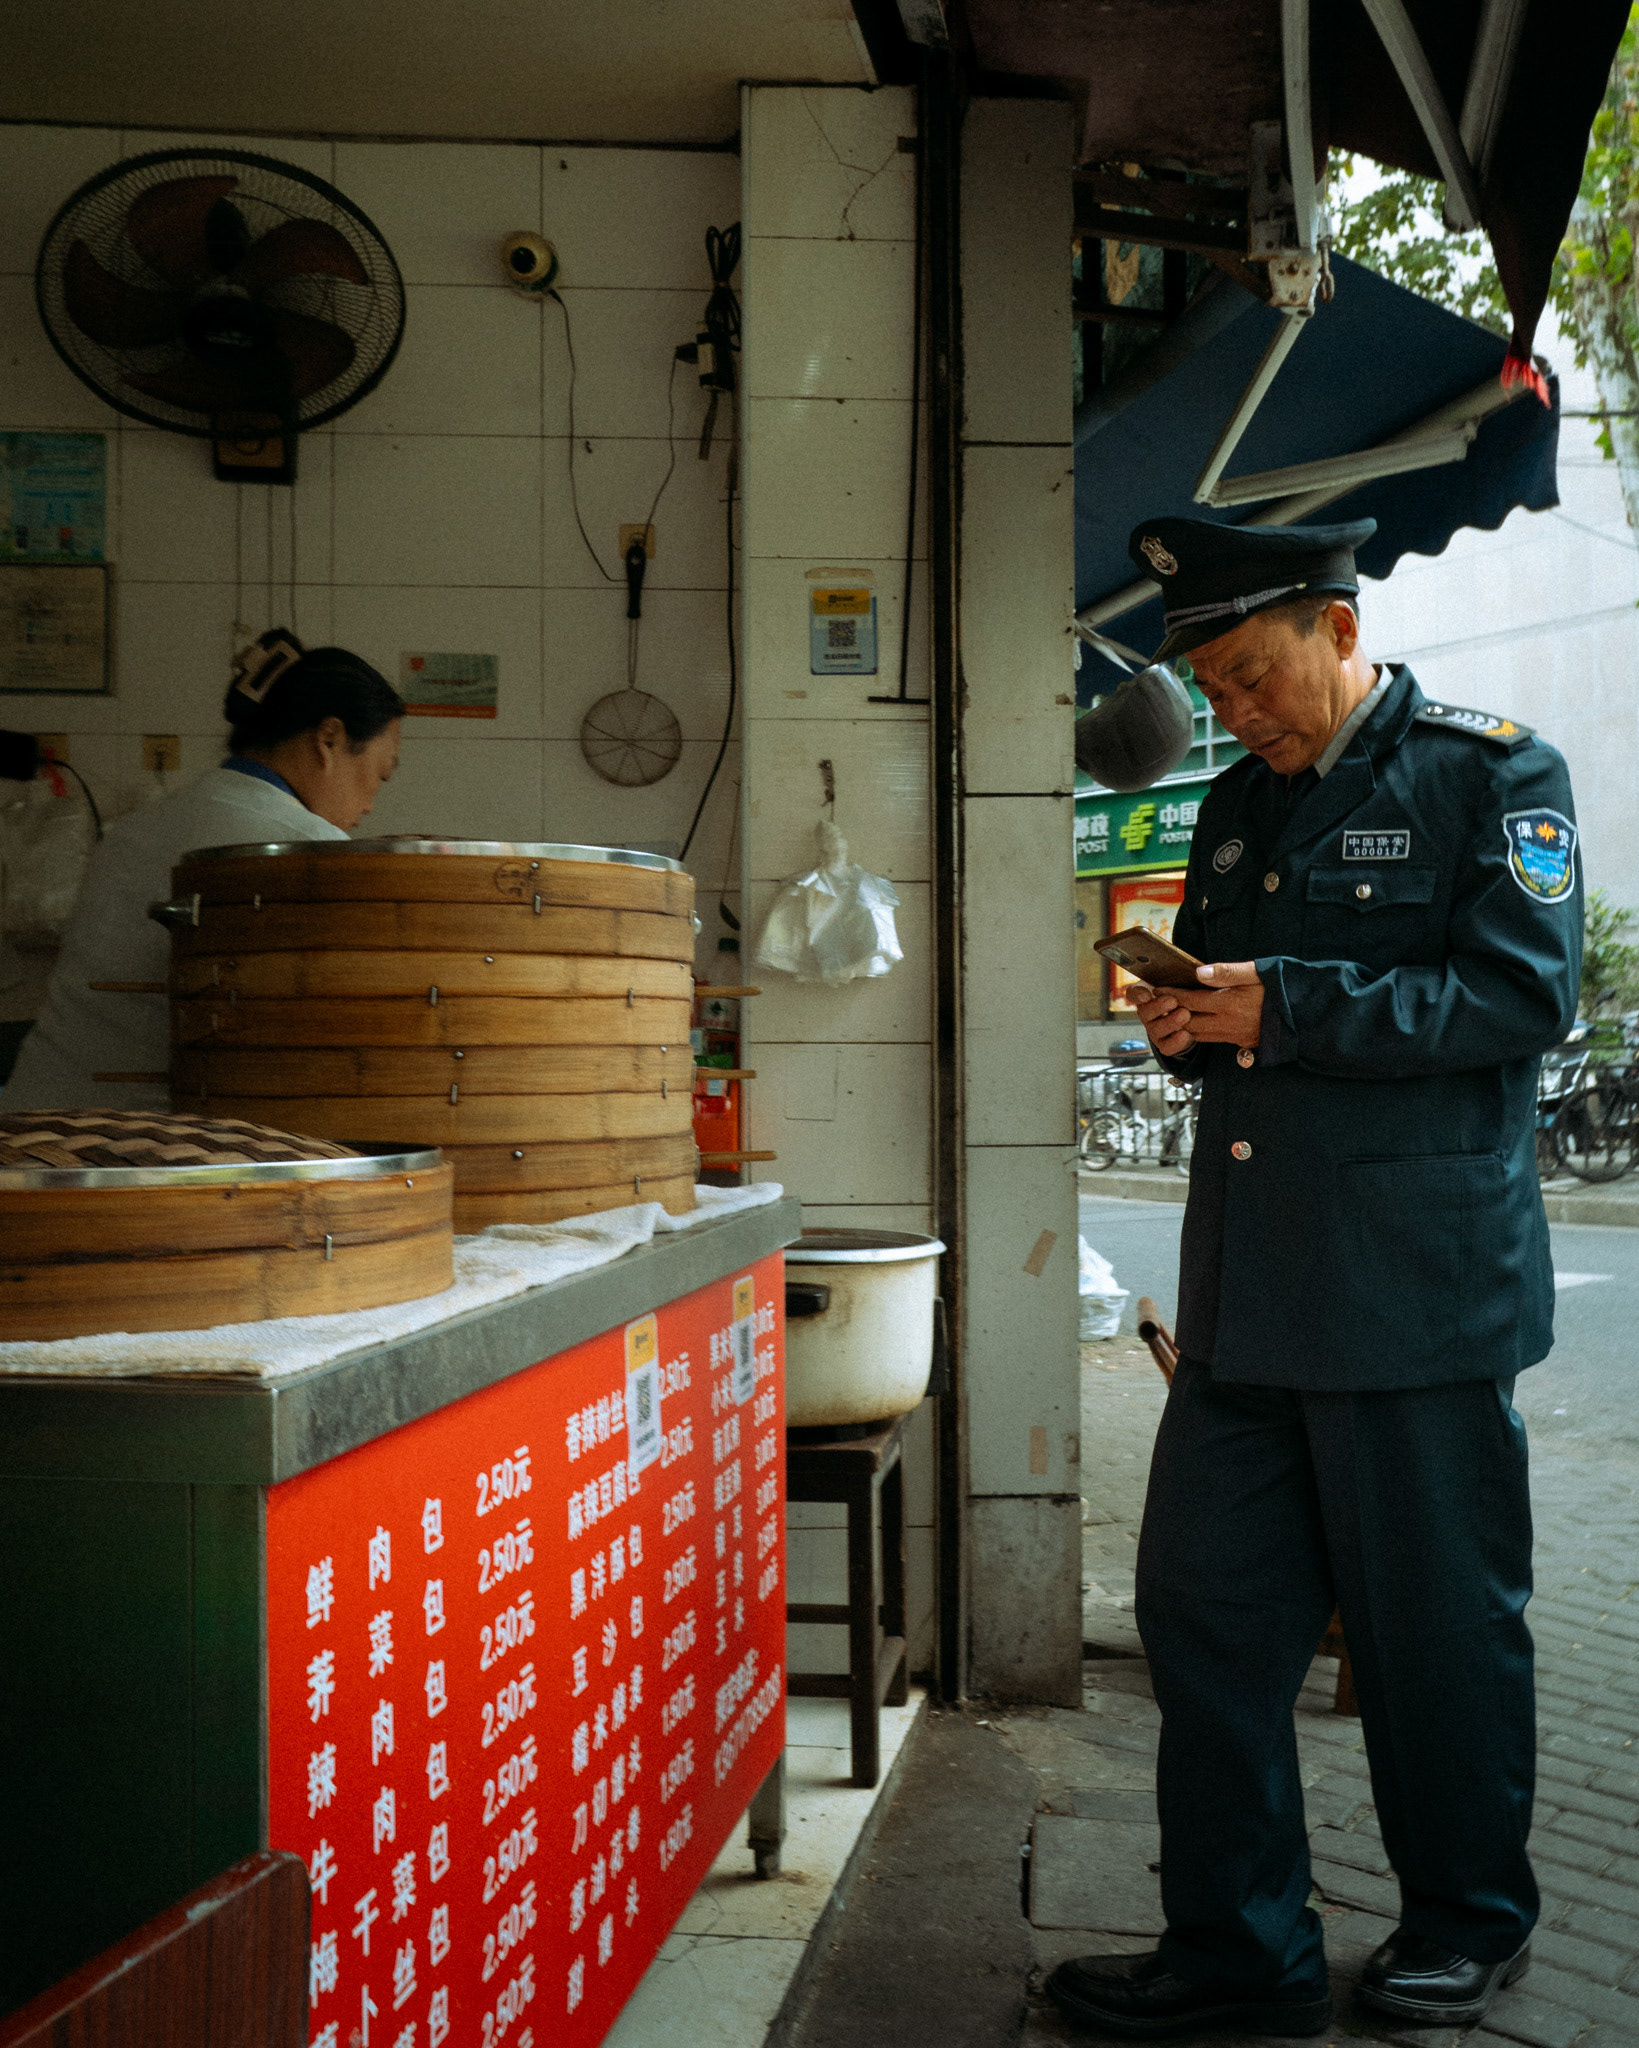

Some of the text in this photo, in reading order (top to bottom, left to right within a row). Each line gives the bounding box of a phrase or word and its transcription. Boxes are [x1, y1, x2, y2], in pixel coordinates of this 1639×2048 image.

[1077, 839, 1110, 855] POST
[1159, 801, 1199, 829] 中国
[1348, 836, 1405, 848] 中国保安
[1516, 821, 1532, 839] 保
[566, 1390, 627, 1464] 香辣粉丝
[660, 1416, 693, 1466] 2.50元
[306, 1446, 532, 1628] 鲜肉包 2.50元
[571, 1481, 695, 1619] 黑洋酥包 2.50元
[307, 1518, 533, 1722] 荠菜包 2.50元
[573, 1546, 696, 1696] 豆沙包 2.50元
[662, 1610, 696, 1670] 2.50元
[308, 1590, 535, 1818] 辣肉包 2.50元
[309, 1663, 536, 1904] 牛肉包 2.50元
[572, 1675, 695, 1853] 刀切馒头 1.50元
[308, 1735, 537, 2008] 梅干菜包 2.50元
[483, 1808, 537, 1903] 2.50元
[571, 1739, 694, 1931] 葱油花卷 1.50元
[660, 1804, 692, 1870] 1.50元
[482, 1881, 536, 1981] 2.50元
